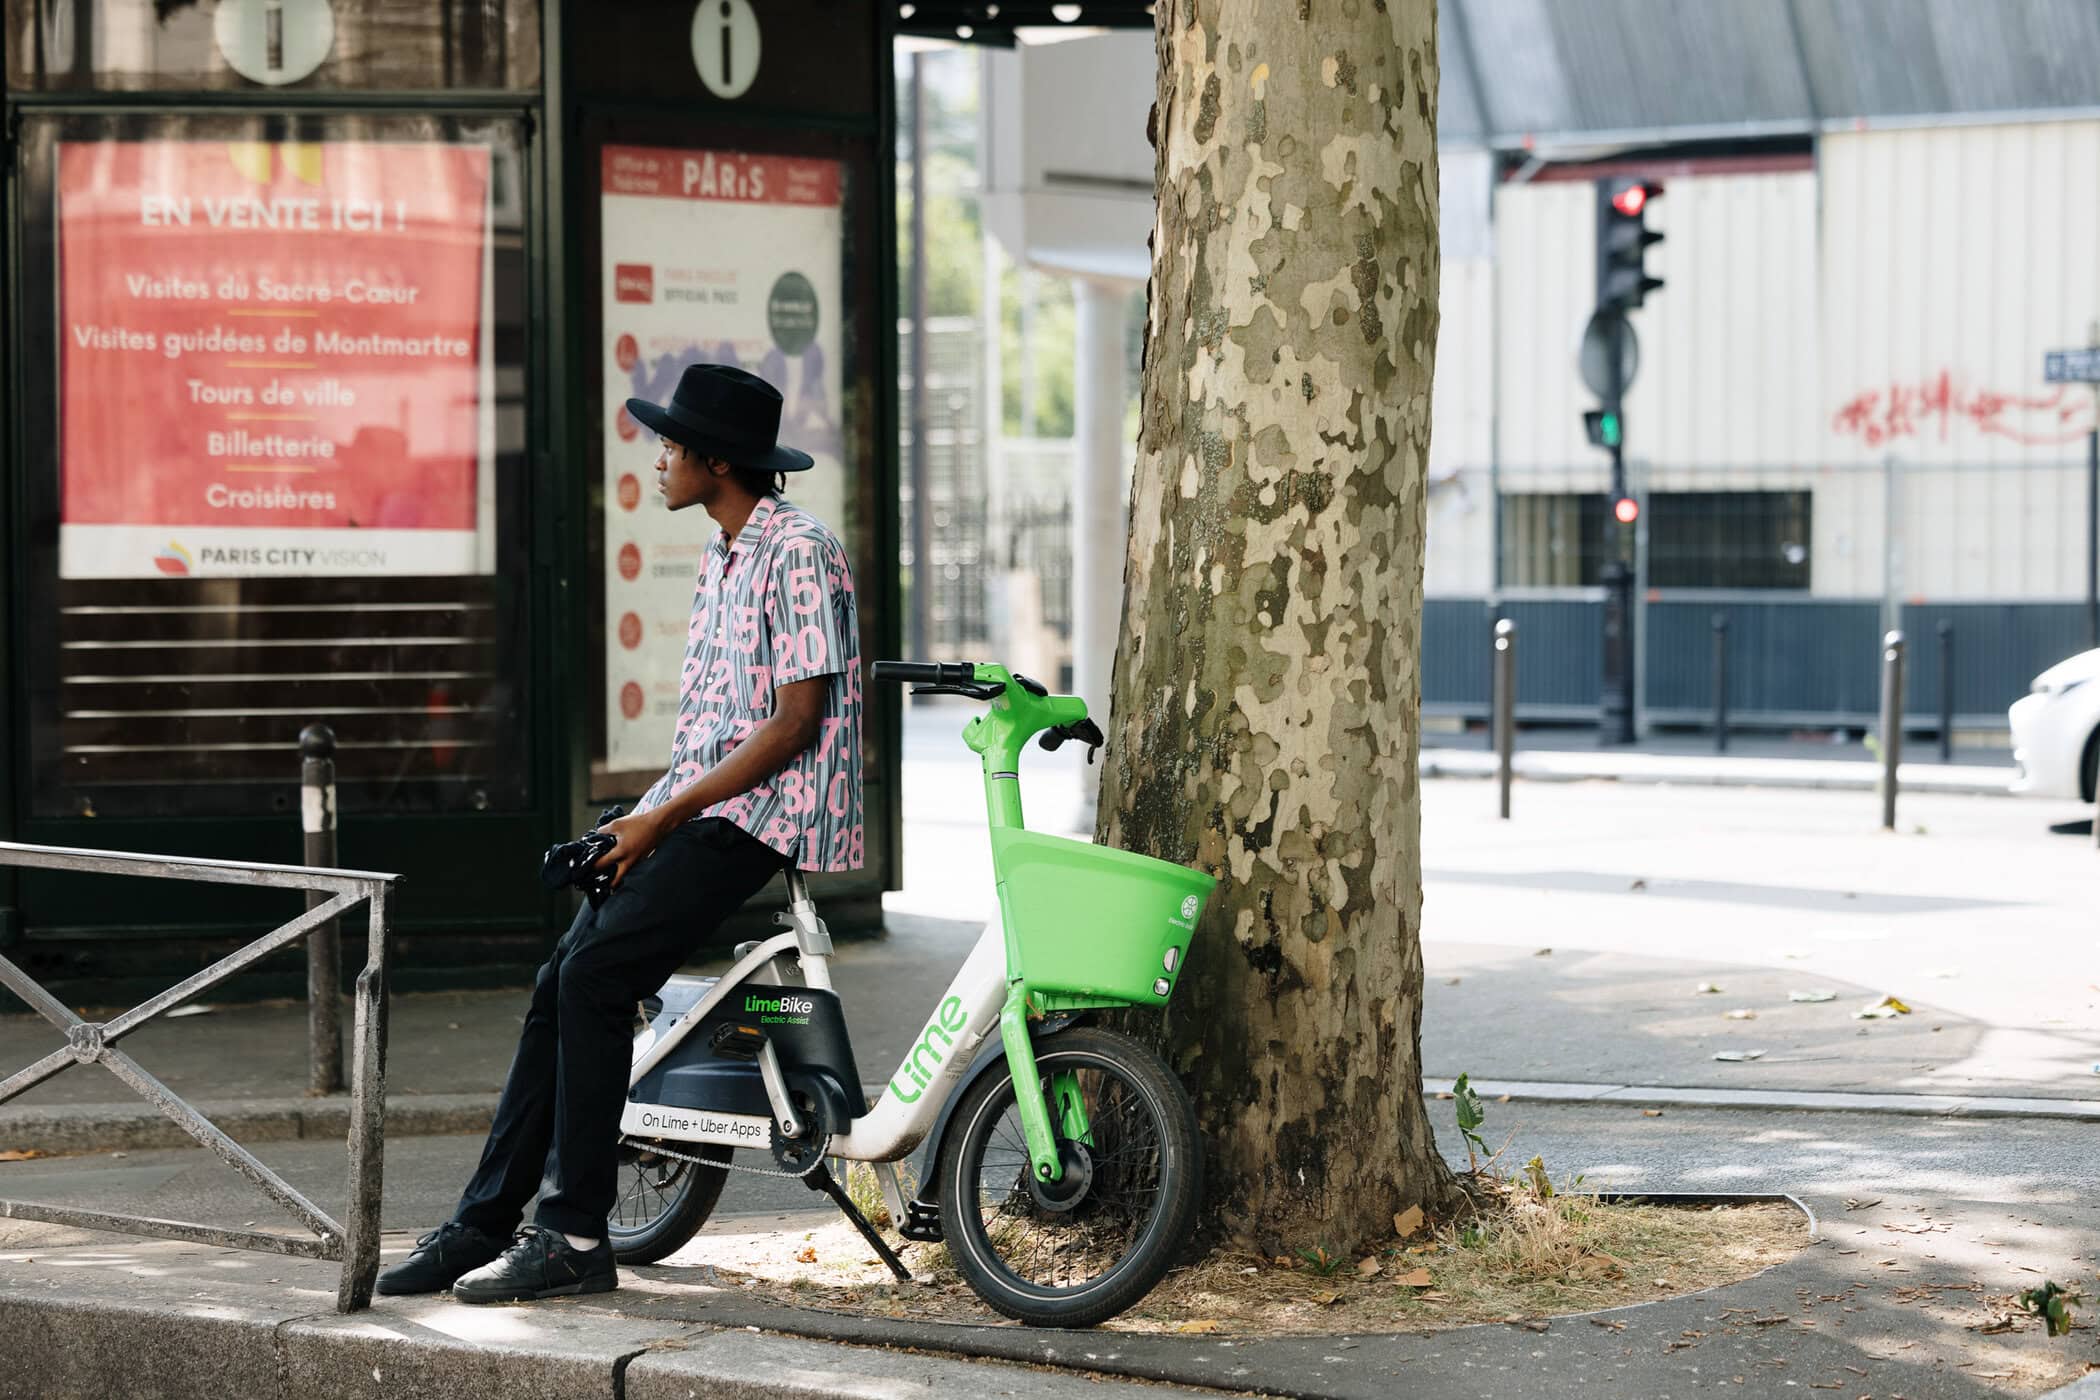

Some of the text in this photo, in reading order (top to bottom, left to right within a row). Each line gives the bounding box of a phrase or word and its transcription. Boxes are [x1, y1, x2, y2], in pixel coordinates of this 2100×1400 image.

[720, 0, 732, 85] i
[140, 197, 193, 227] EN
[203, 197, 320, 230] VENTE
[331, 200, 384, 232] ICI
[127, 272, 210, 300] Visites
[217, 275, 249, 300] du
[74, 324, 471, 359] Visites guidées de Montmartre
[187, 378, 355, 407] Tours de ville
[207, 430, 336, 458] Billetterie
[206, 482, 337, 510] Croisières
[789, 566, 822, 615] 5
[745, 995, 813, 1014] LimeBike
[761, 1015, 810, 1025] Electric Assist
[642, 1113, 660, 1127] On
[661, 1114, 689, 1131] Lime
[700, 1118, 729, 1134] Uber
[730, 1121, 761, 1139] Apps
